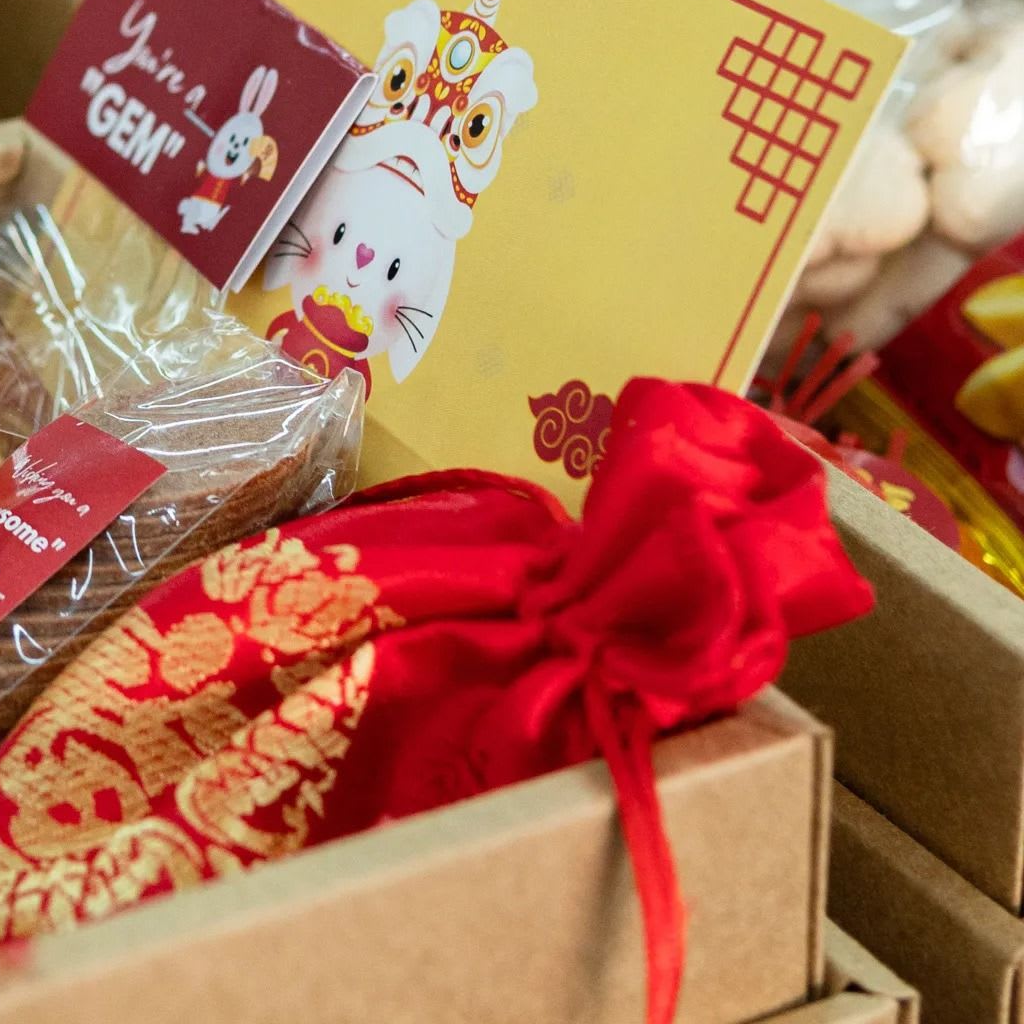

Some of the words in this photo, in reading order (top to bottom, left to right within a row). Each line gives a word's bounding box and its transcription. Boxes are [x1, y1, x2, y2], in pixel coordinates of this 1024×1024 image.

[80, 66, 186, 175] "GEM"
[32, 487, 77, 505] you
[76, 503, 91, 518] a
